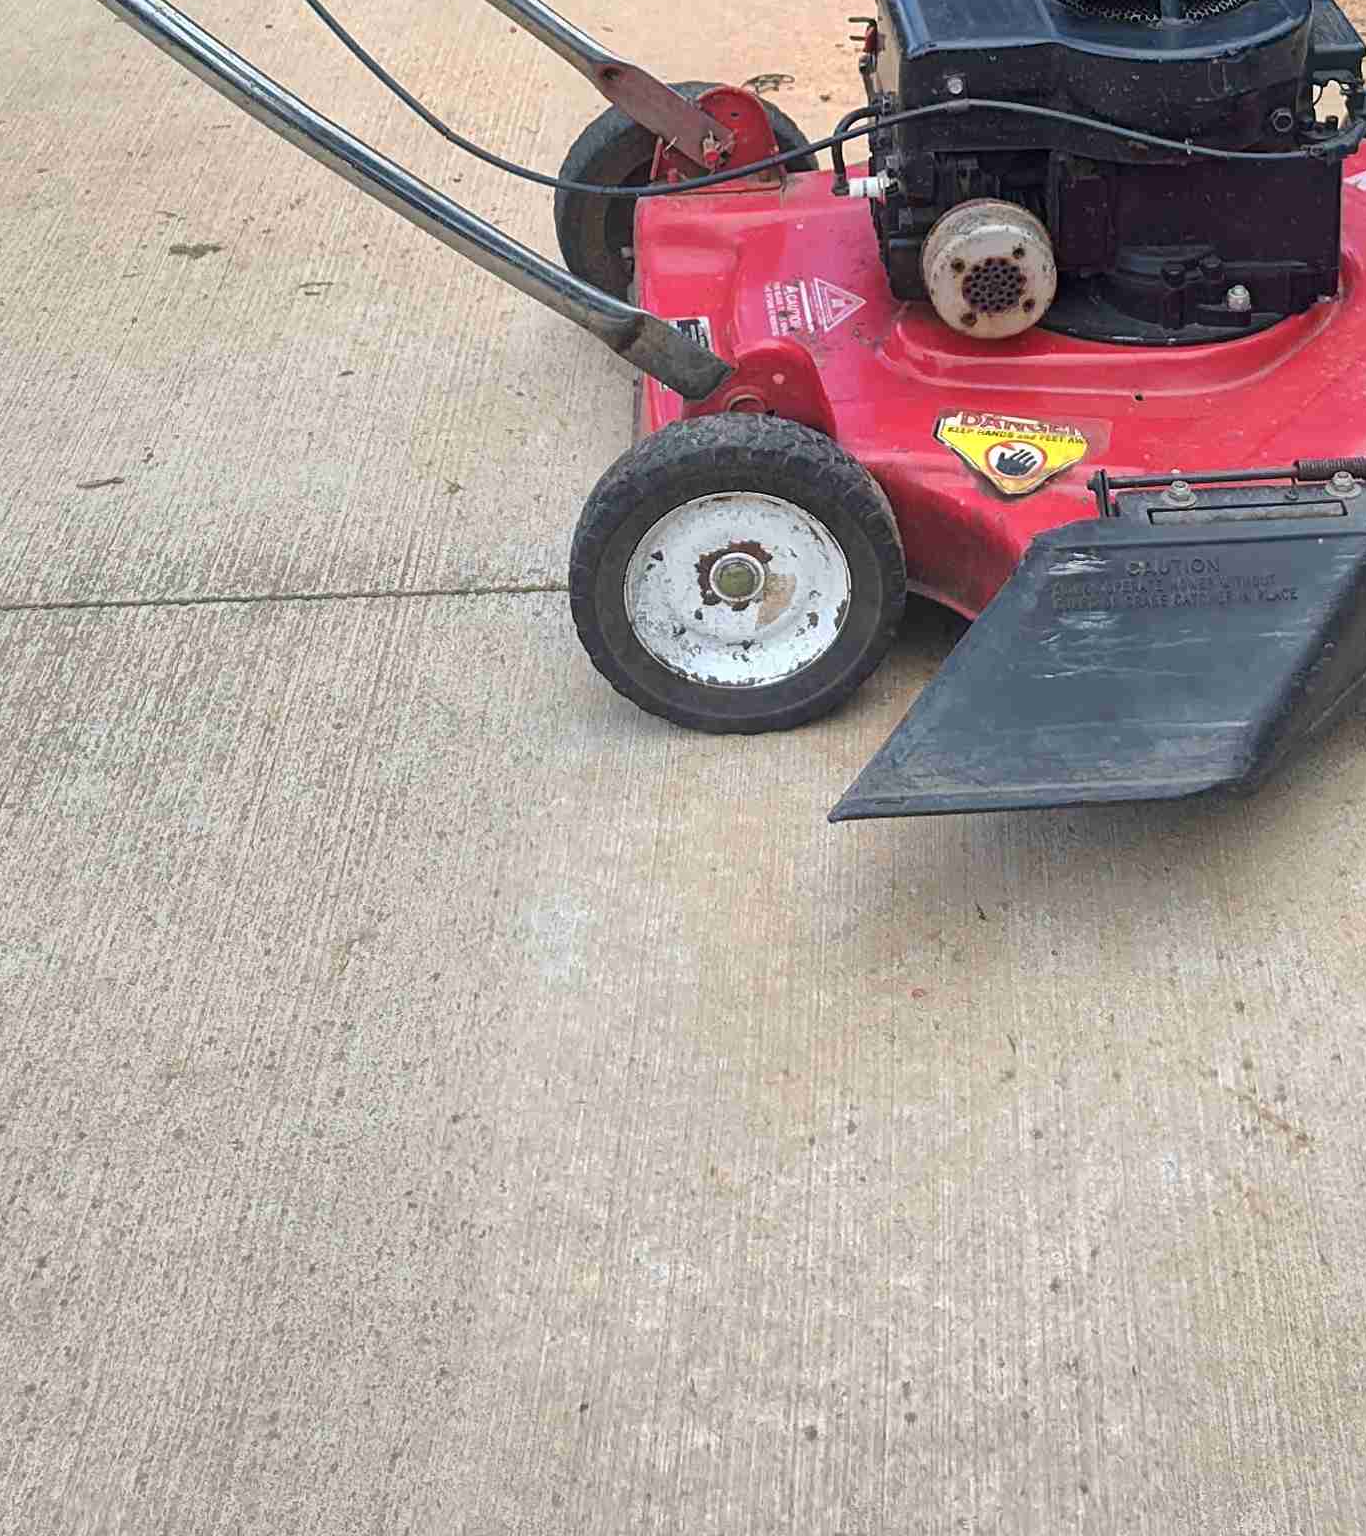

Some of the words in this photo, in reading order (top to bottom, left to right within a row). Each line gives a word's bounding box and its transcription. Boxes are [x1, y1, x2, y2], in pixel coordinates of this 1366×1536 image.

[947, 426, 973, 434] KEEP
[977, 429, 1014, 438] HANDS
[1039, 434, 1064, 443] FEET
[1126, 558, 1219, 576] CAUTION
